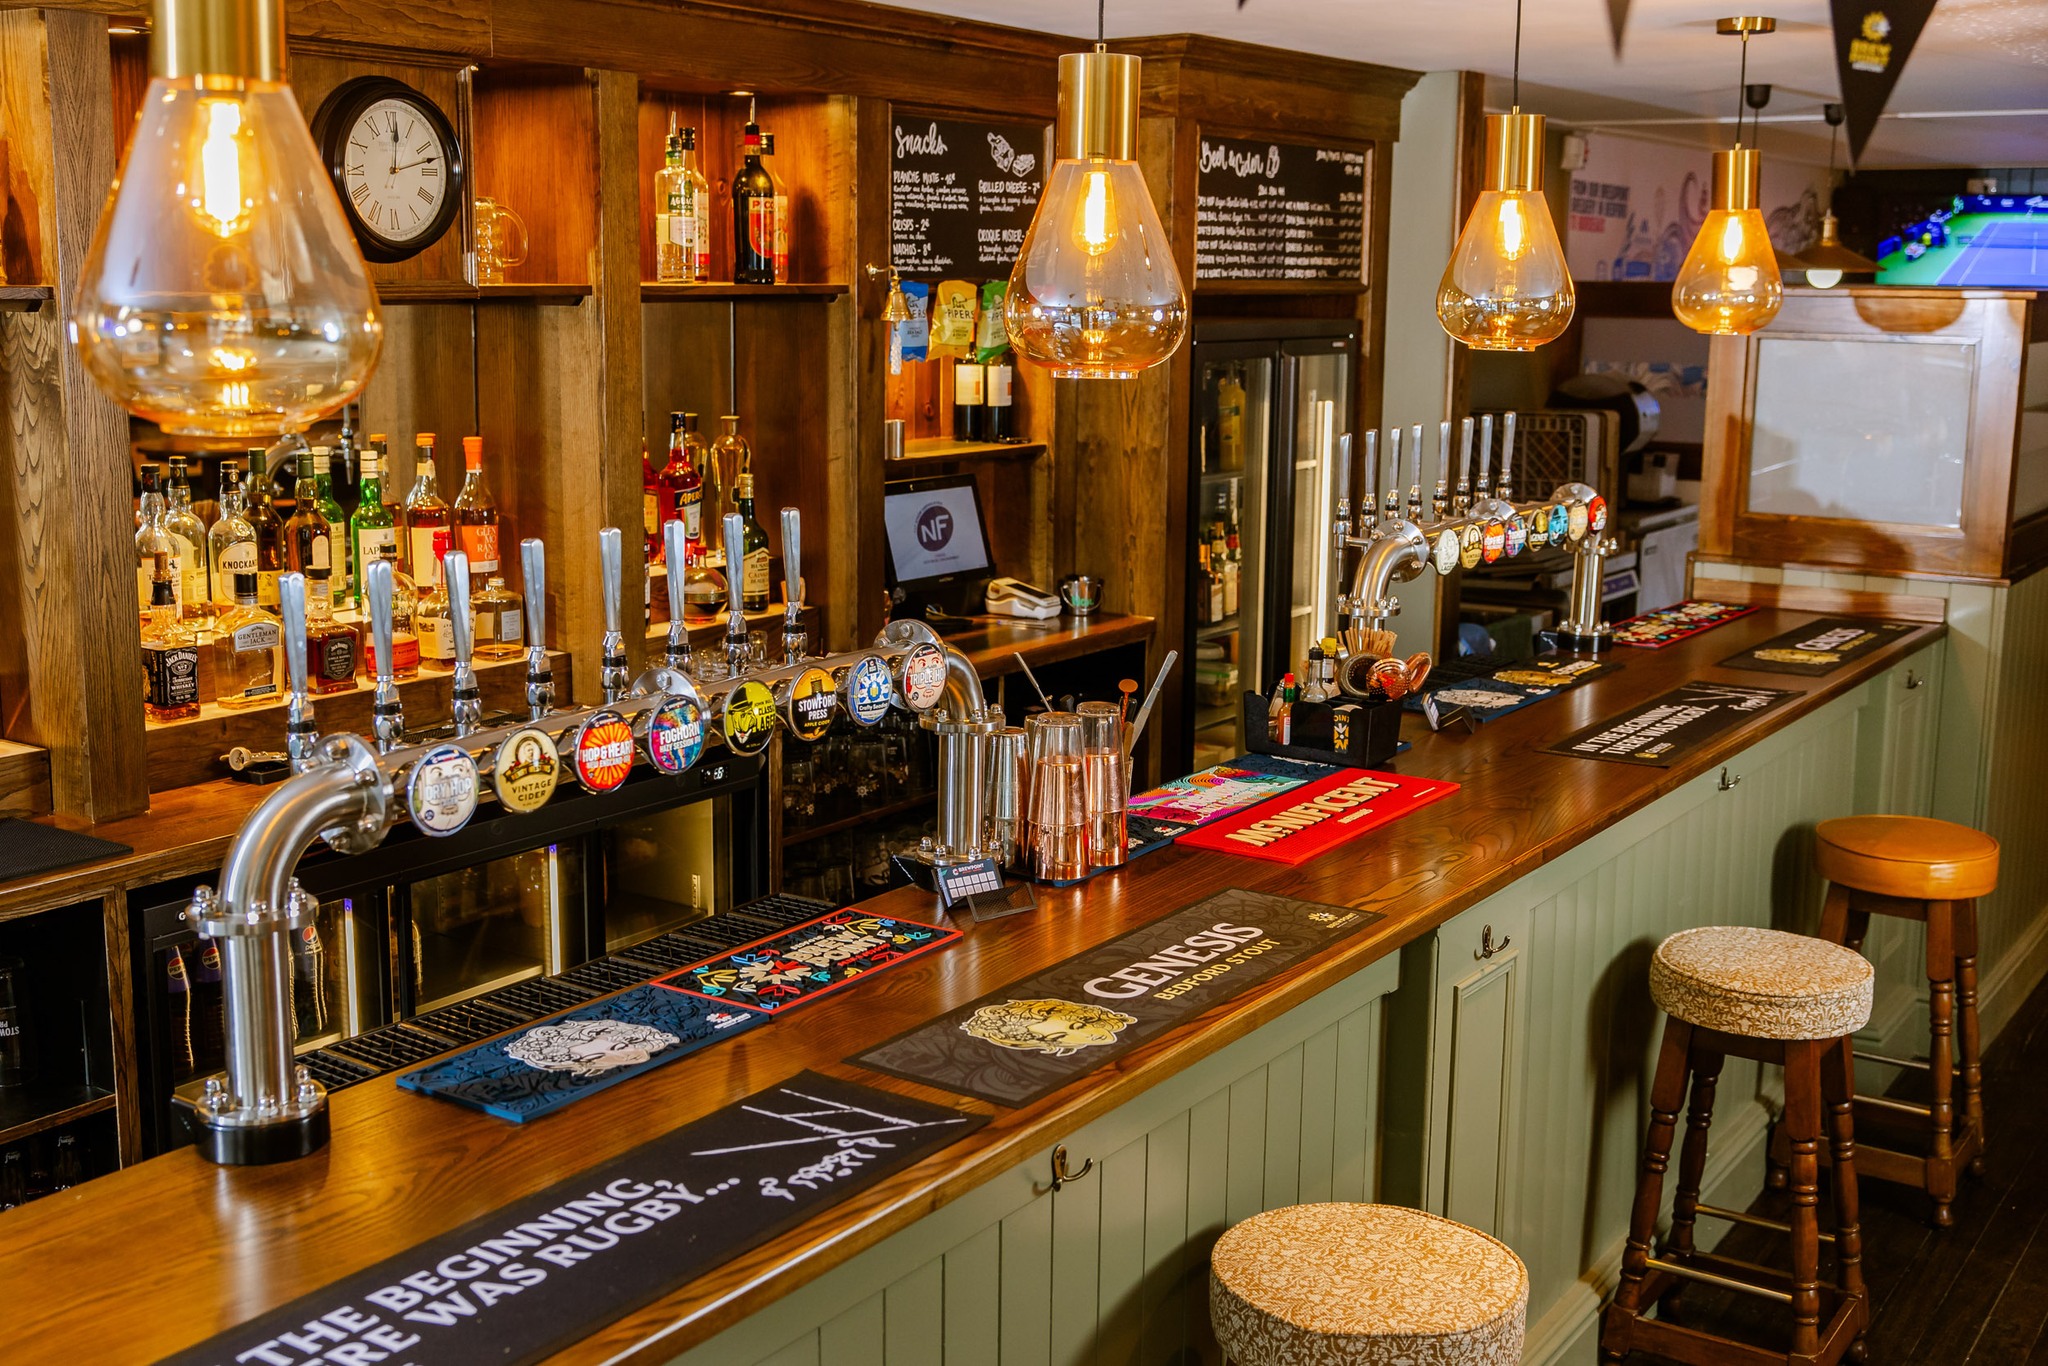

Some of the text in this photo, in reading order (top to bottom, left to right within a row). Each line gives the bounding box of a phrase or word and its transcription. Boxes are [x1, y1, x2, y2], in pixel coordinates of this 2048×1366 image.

[350, 135, 368, 155] X
[894, 122, 949, 159] Snacks
[1199, 140, 1228, 174] Beer
[1234, 151, 1264, 178] Cider
[893, 170, 920, 184] PLANCHE
[978, 179, 1005, 194] GRILLED
[1005, 181, 1028, 194] CHEESE
[892, 218, 914, 232] CRISPS
[978, 228, 1001, 244] CROQUE
[892, 243, 917, 256] NACHOS
[947, 307, 975, 320] PIPERS
[921, 514, 949, 543] NF
[237, 629, 277, 641] GENTLEMAN
[250, 637, 266, 645] JACK
[165, 654, 179, 668] JACK
[910, 672, 936, 686] TRIPLE
[798, 693, 837, 712] STOWFORD
[808, 708, 828, 721] PRESS
[659, 721, 701, 746] FOGHORN
[1571, 741, 1596, 753] IN
[1584, 726, 1627, 747] THE
[1600, 734, 1654, 756] THERE
[1644, 722, 1679, 741] WAS
[582, 747, 600, 763] HOP
[607, 739, 634, 757] HEART
[425, 776, 472, 801] DRY HOP
[511, 779, 553, 794] VINTAGE
[517, 789, 546, 802] CIDER
[781, 930, 861, 962] BREW
[805, 935, 887, 968] POINT
[1083, 921, 1264, 999] GENESIS
[1153, 938, 1281, 1002] BEDFORD STOUT
[235, 1177, 674, 1366] THE BEGINNING,
[403, 1262, 548, 1326] WAS
